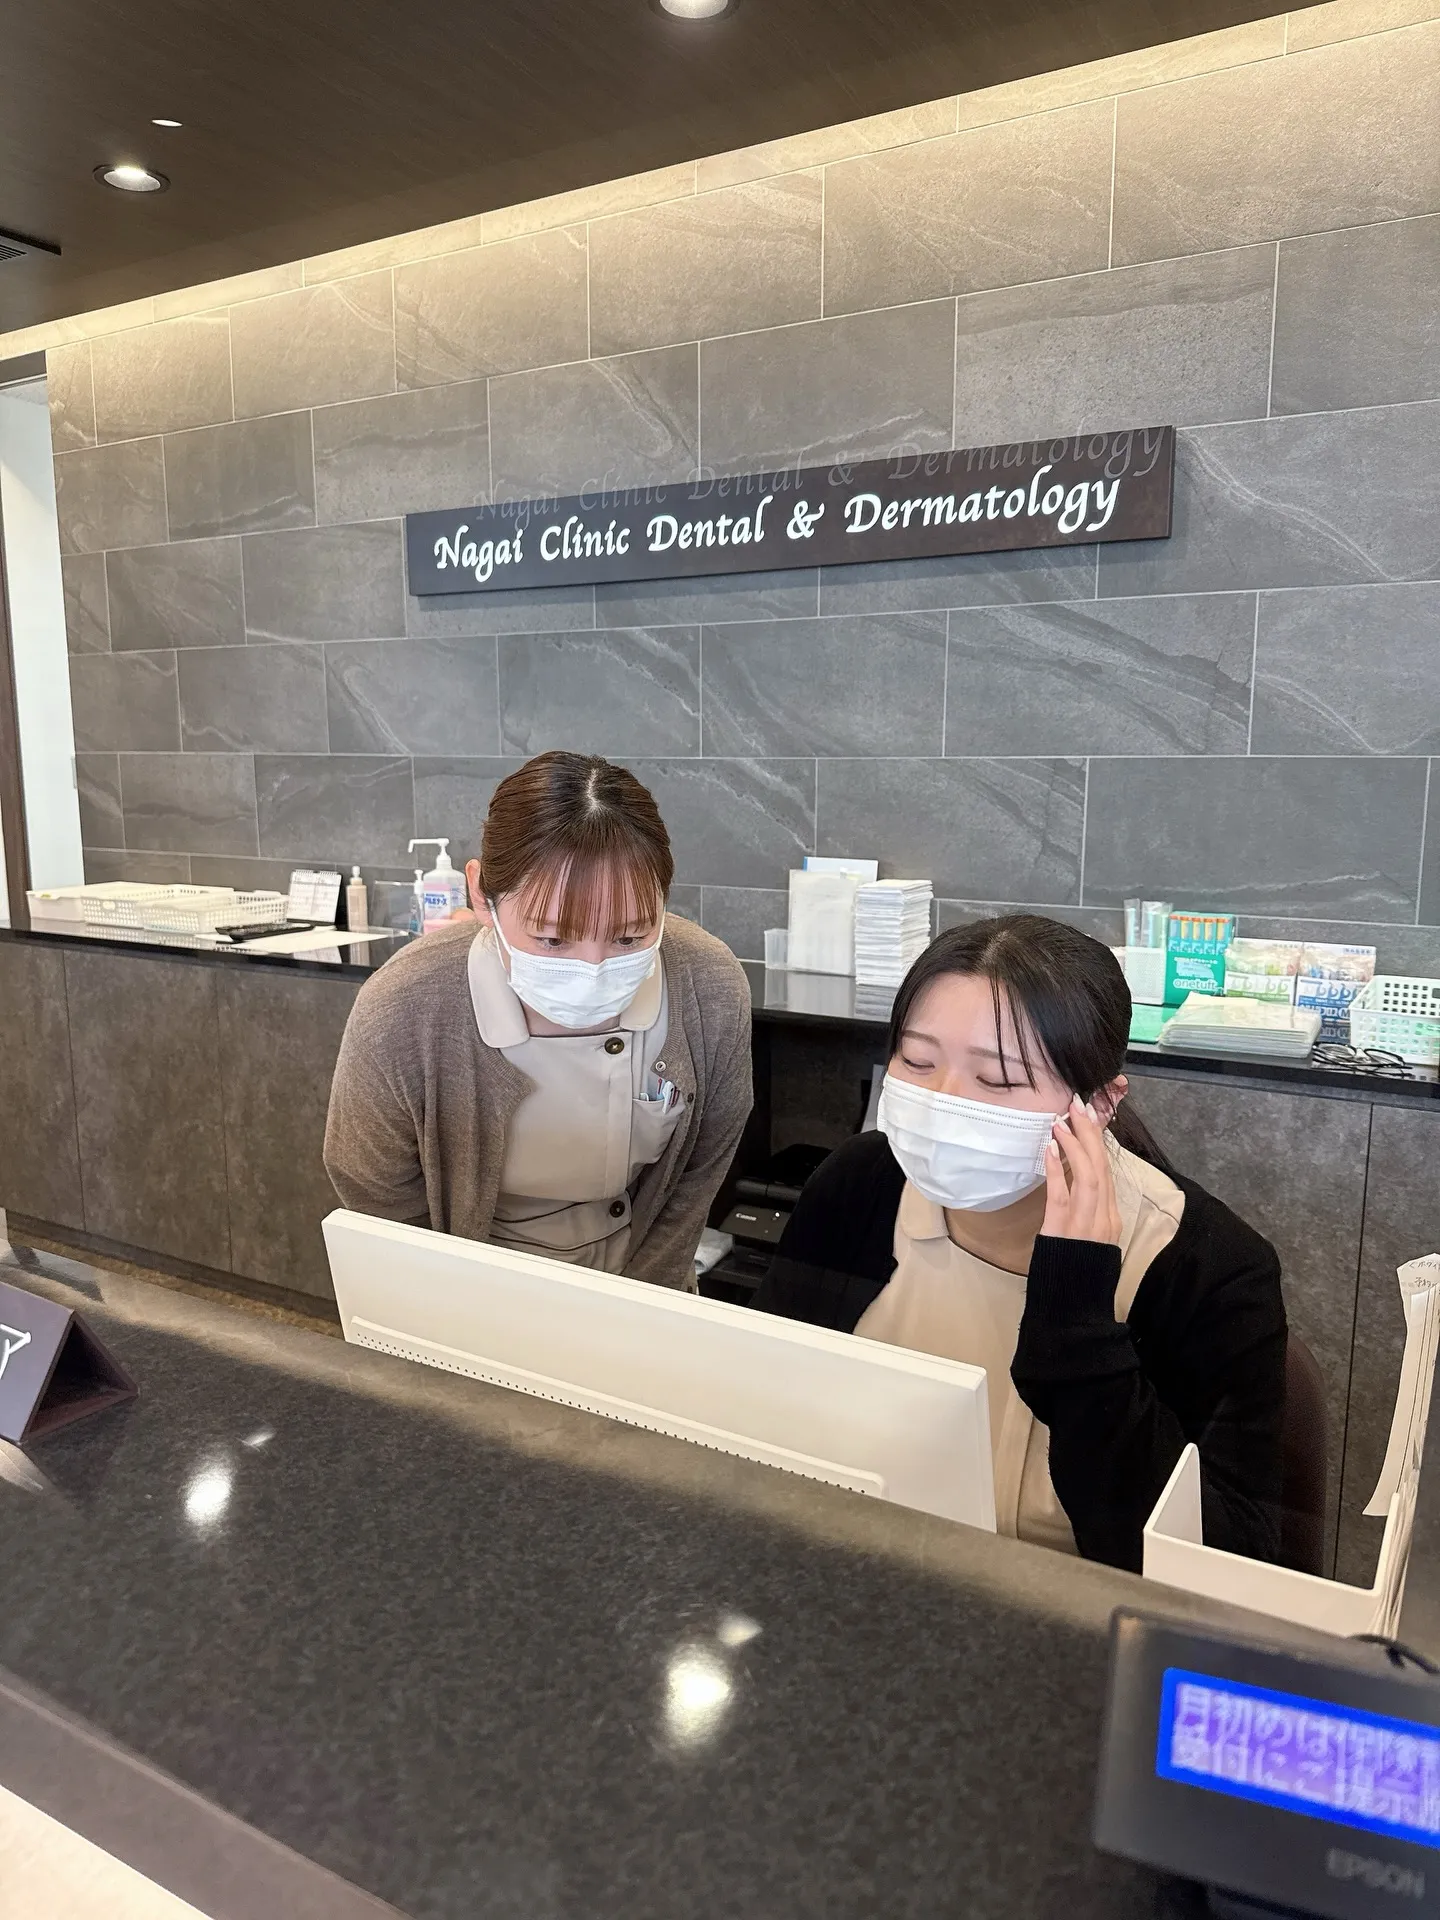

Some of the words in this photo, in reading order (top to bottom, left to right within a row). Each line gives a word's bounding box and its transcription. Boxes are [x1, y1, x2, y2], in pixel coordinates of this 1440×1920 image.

[578, 467, 668, 511] Clinic
[686, 449, 806, 501] Dental
[434, 524, 524, 583] Nagai
[539, 516, 631, 562] Clinic
[646, 495, 774, 552] Dental
[786, 500, 825, 540] &
[844, 465, 1121, 535] Dermatology
[1174, 978, 1217, 990] onetuft
